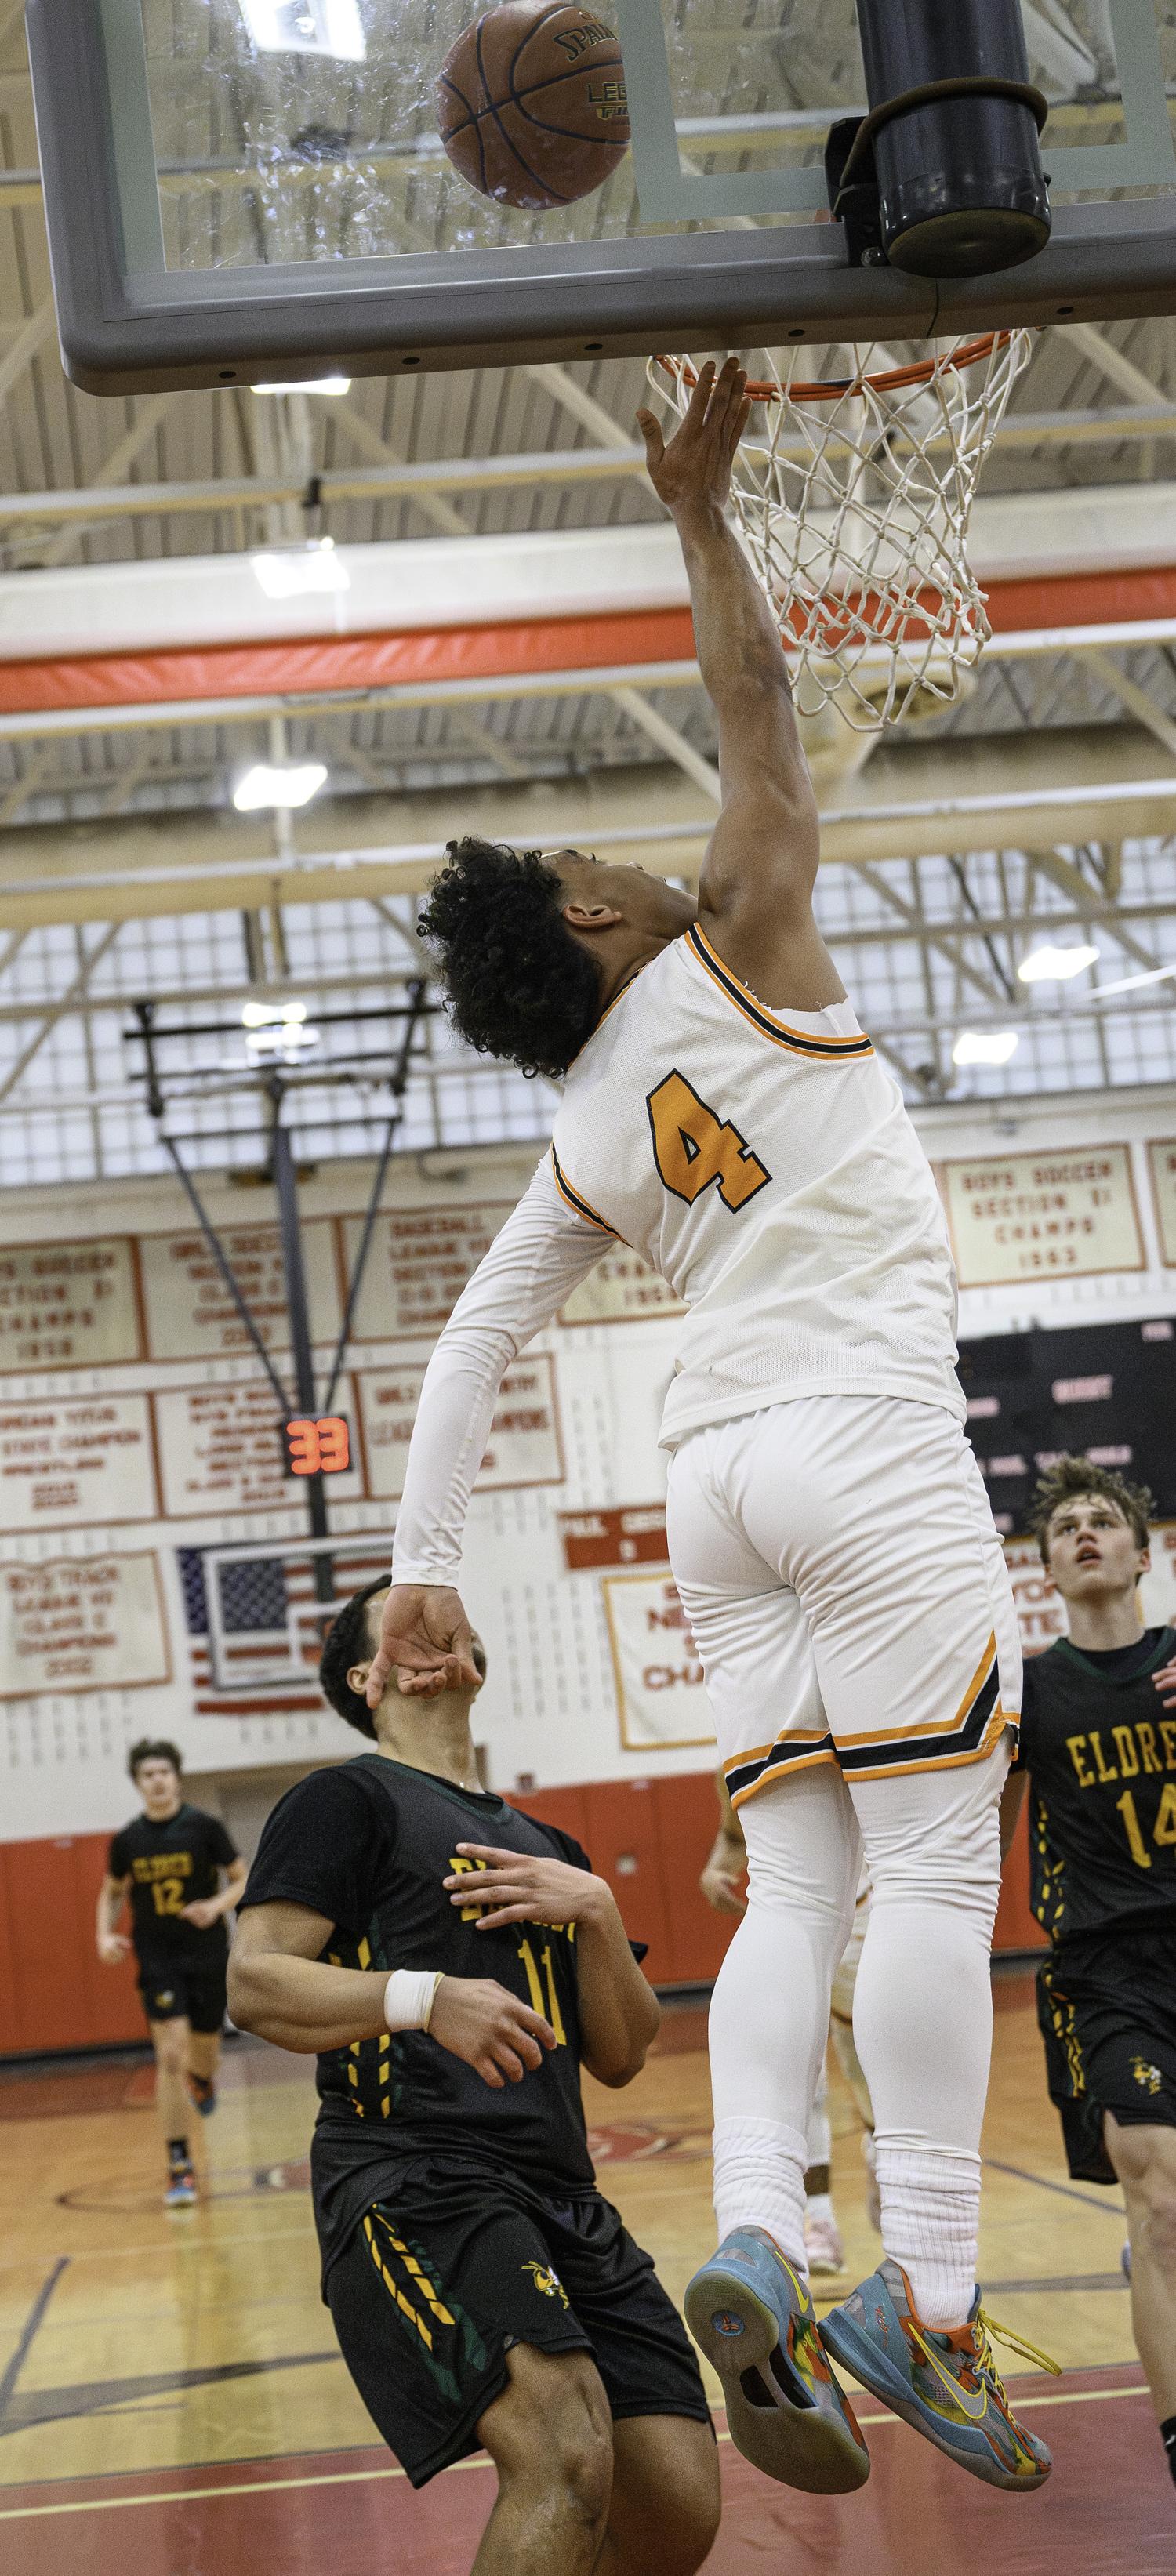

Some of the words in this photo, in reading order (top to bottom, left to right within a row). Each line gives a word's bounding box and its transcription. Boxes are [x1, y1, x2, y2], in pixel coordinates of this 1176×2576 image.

[646, 1068, 773, 1214] 4
[961, 1173, 1015, 1192] BOYS
[1033, 1161, 1112, 1186] SOCCER
[971, 1194, 1066, 1220] SECTION
[994, 1217, 1094, 1245] CHAMPS
[286, 1417, 350, 1475] 33
[1116, 1783, 1176, 1868] 14
[152, 1878, 187, 1917] 12
[517, 1939, 567, 2045] 11
